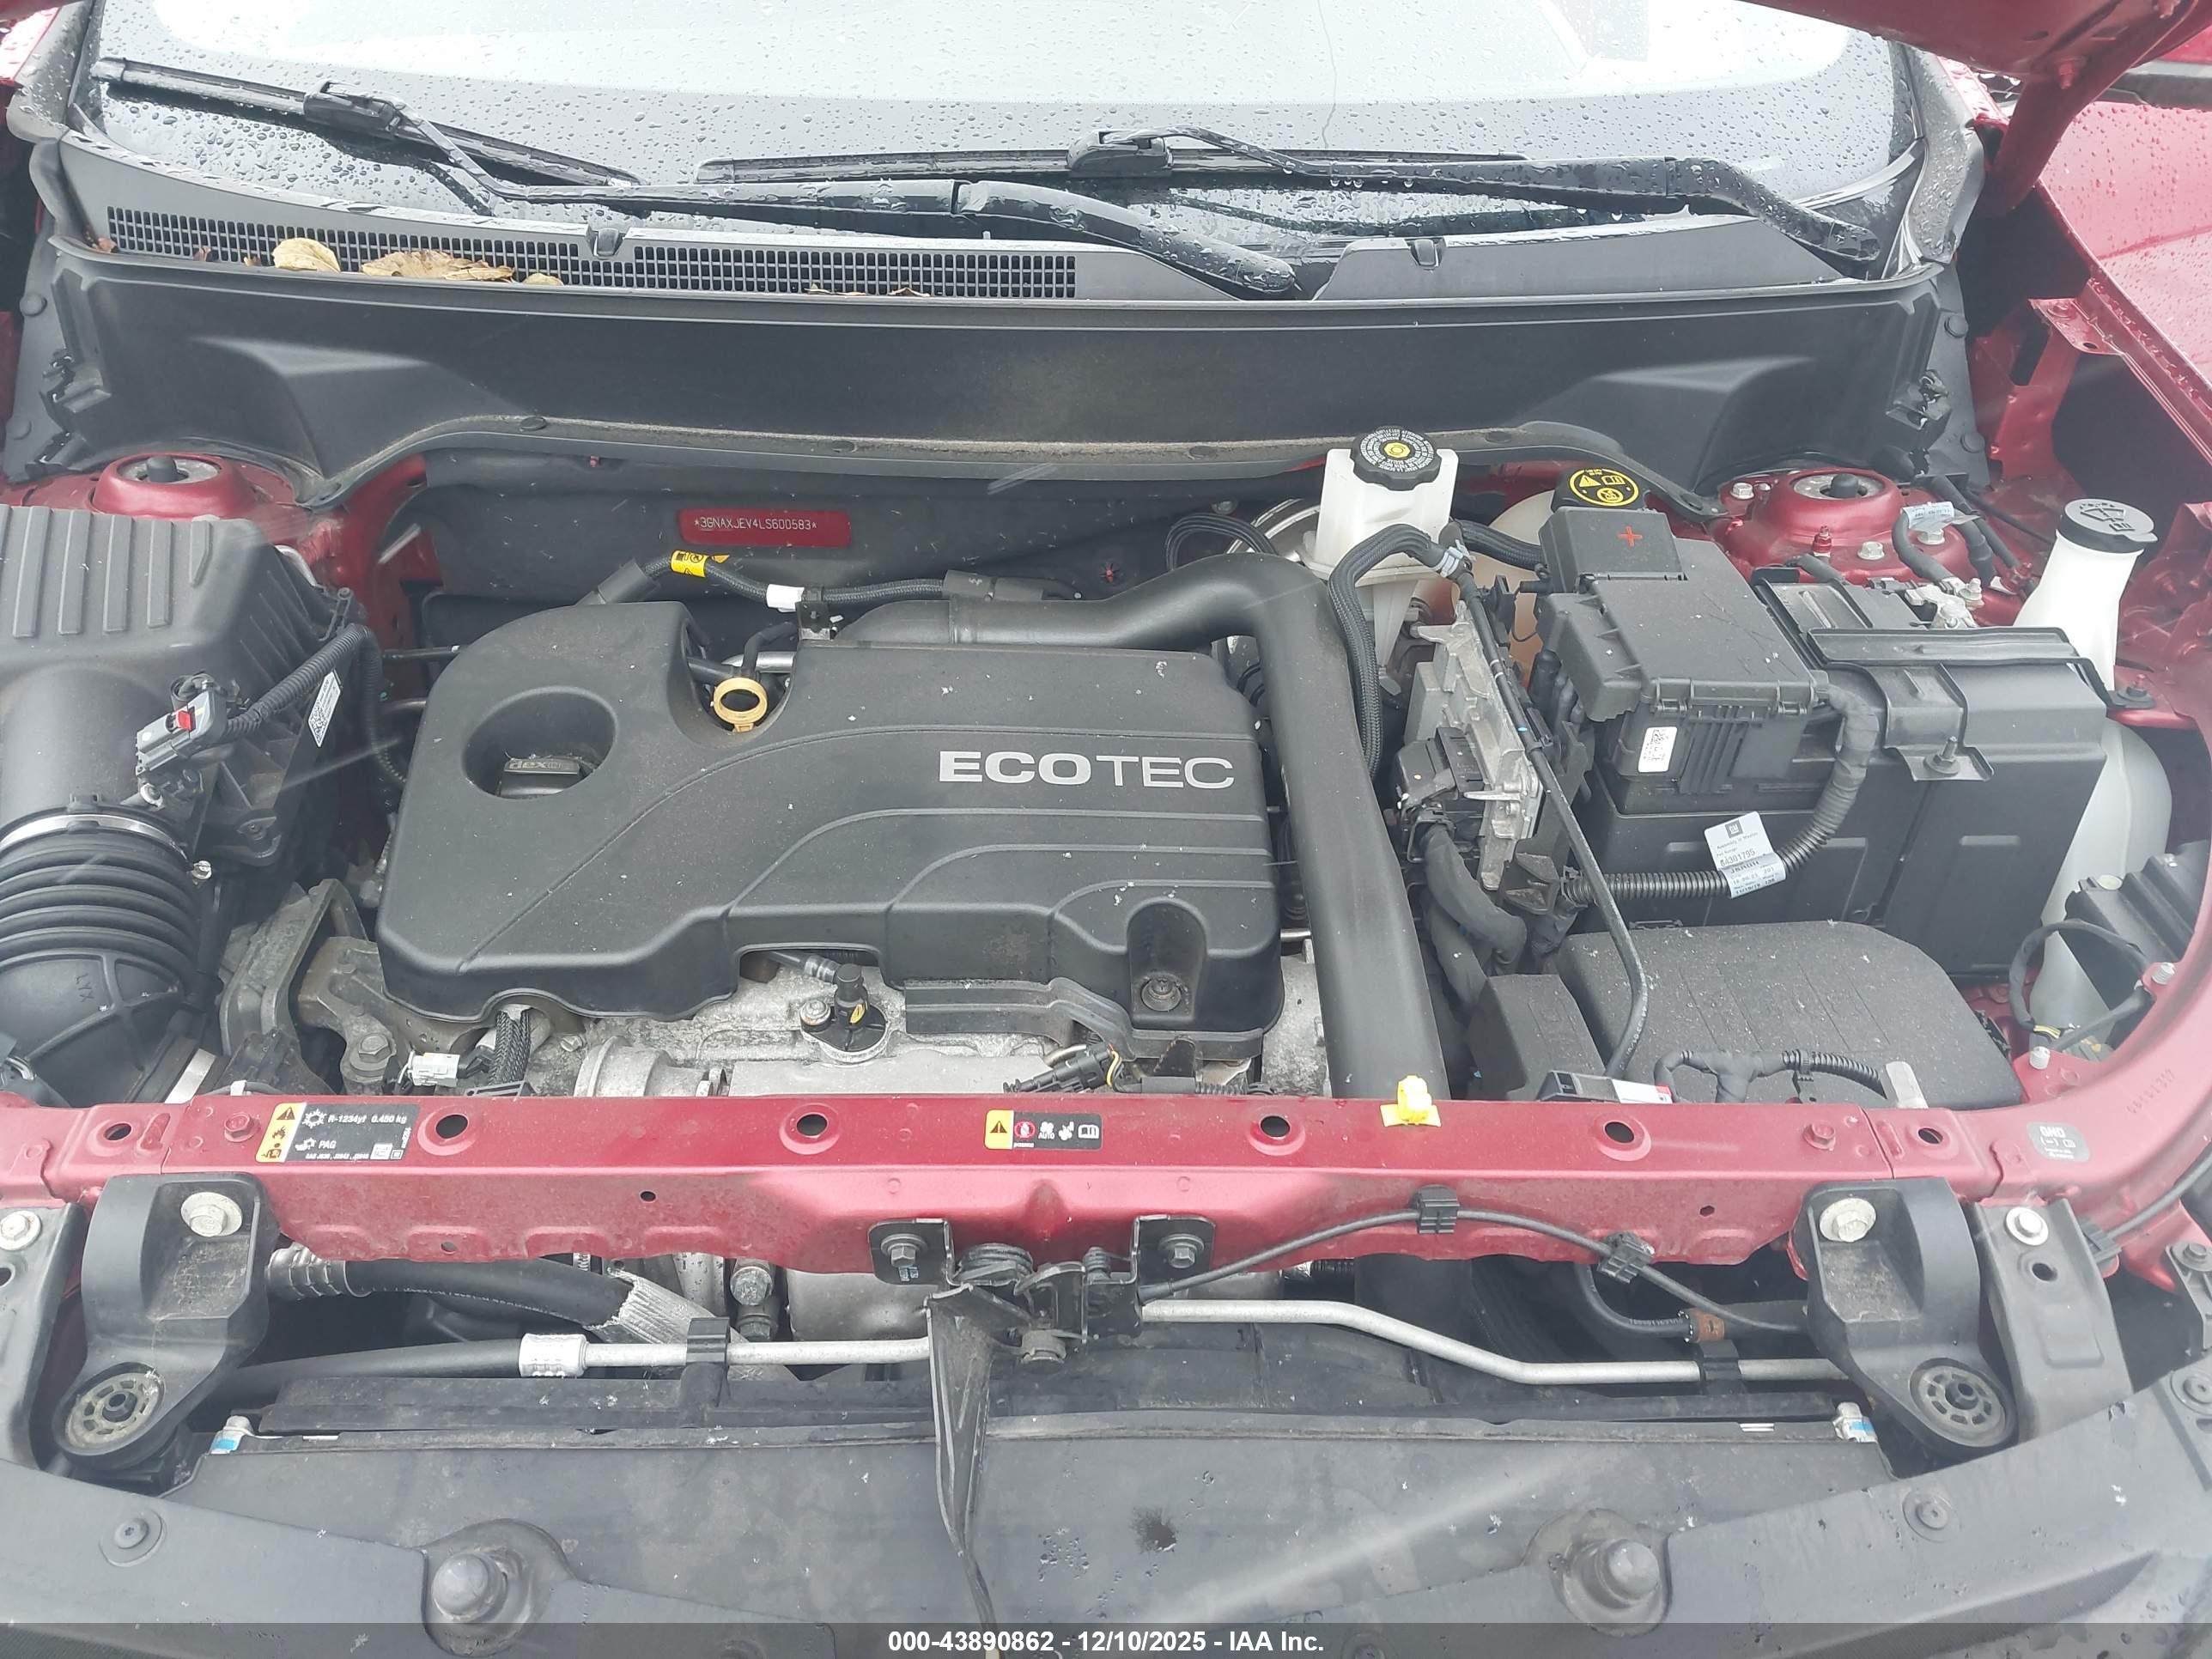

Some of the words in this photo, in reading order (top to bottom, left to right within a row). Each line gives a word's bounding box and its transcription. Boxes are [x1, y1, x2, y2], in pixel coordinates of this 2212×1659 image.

[939, 750, 1235, 789] ECOTEC
[396, 1114, 407, 1124] kg
[1037, 1131, 1055, 1139] AUTO
[318, 1139, 337, 1150] PAG
